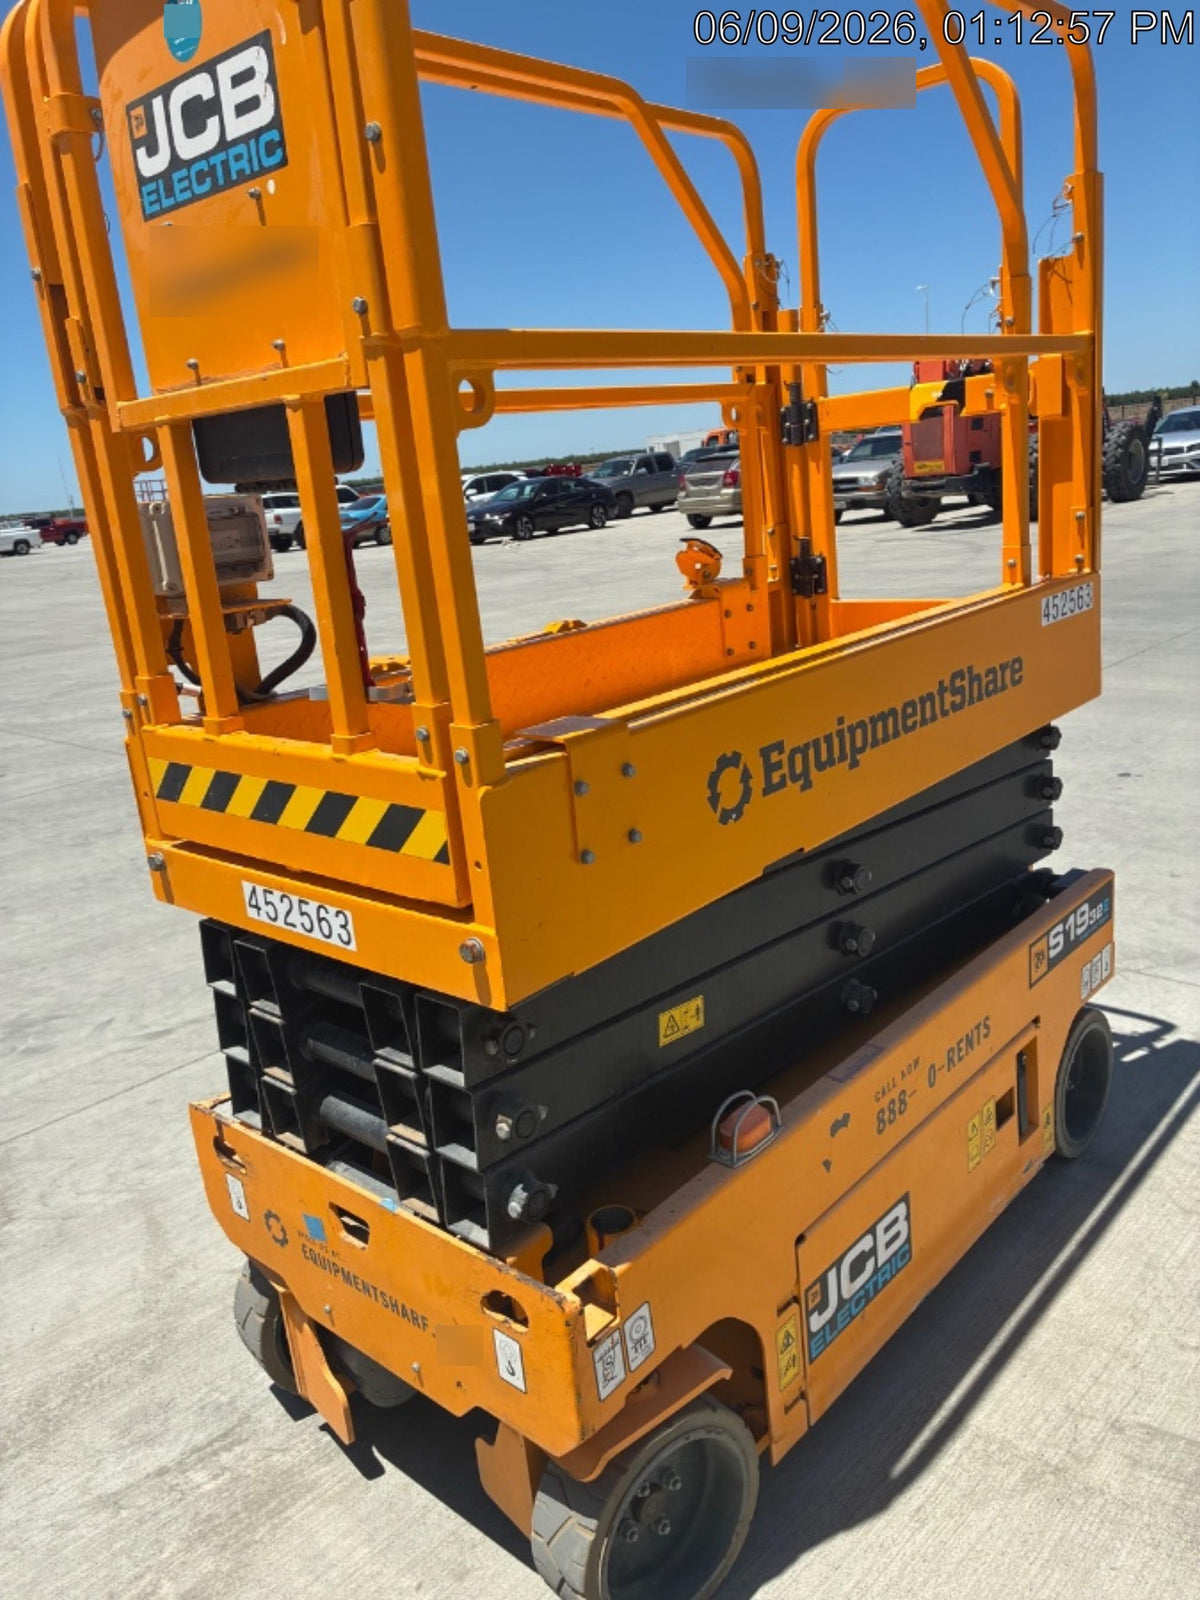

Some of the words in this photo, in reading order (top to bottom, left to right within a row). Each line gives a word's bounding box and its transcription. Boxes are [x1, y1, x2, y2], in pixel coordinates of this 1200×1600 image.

[136, 45, 275, 178] JCB
[141, 129, 284, 216] ELECTRIC
[1043, 582, 1092, 623] 452563
[759, 656, 1024, 797] EquipmentShare
[248, 885, 352, 946] 452563
[809, 1202, 909, 1333] JCB
[810, 1243, 911, 1361] ELECTRIC
